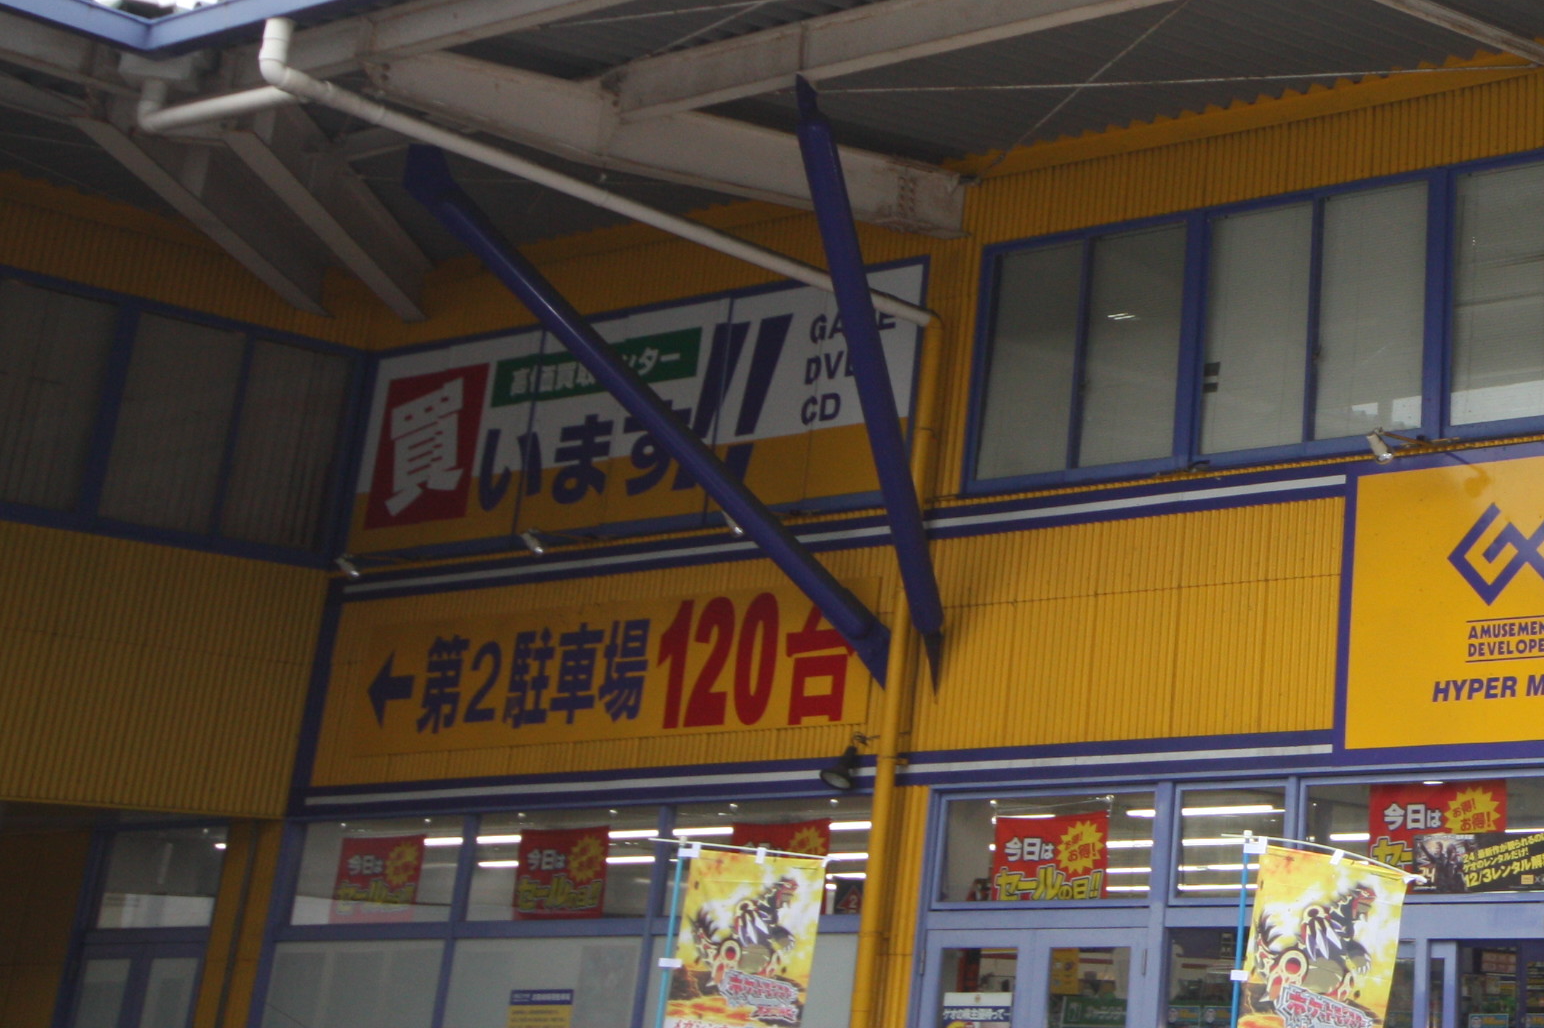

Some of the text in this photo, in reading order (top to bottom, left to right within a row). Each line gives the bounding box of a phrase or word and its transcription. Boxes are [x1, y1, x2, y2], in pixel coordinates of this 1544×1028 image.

[809, 313, 897, 344] GAE
[801, 393, 841, 426] CD
[1432, 674, 1517, 703] HYPER
[1383, 803, 1442, 830] 今日は
[1004, 836, 1055, 861] 今日は
